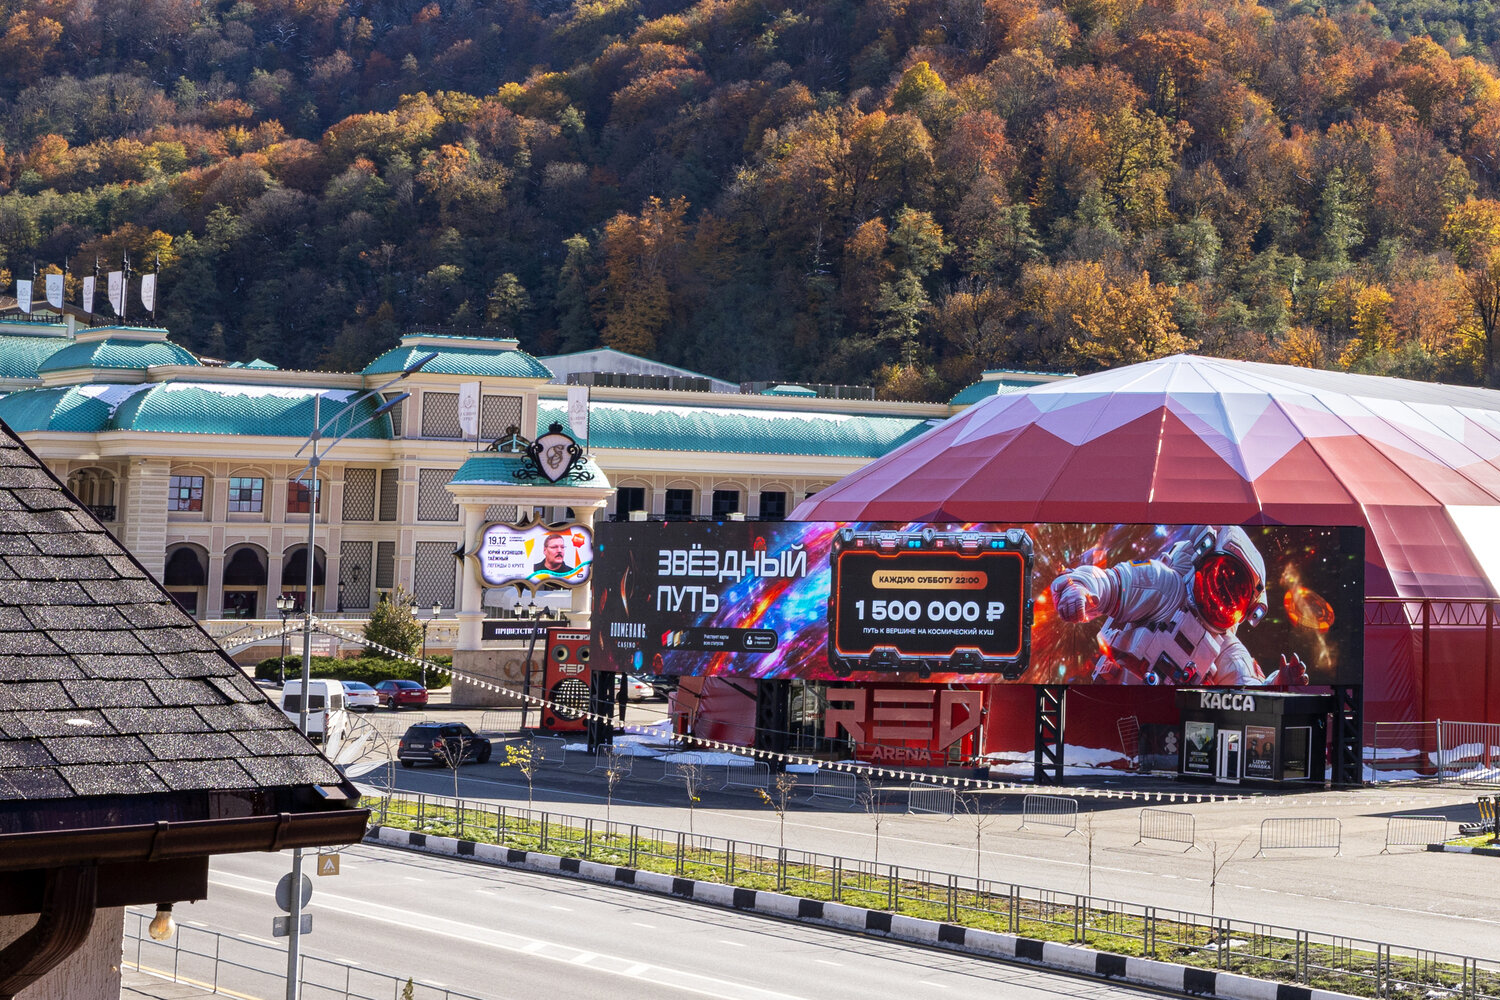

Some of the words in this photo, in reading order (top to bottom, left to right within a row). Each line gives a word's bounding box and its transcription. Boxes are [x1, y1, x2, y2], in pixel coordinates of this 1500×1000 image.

[488, 536, 507, 545] 19.12
[657, 543, 807, 583] ЗВЁЗДНЫЙ
[879, 576, 915, 584] КАЖДУЮ
[917, 576, 954, 584] СУББОТУ
[656, 585, 719, 613] ПУТЬ
[855, 600, 865, 620] 1
[871, 600, 922, 621] 500
[927, 601, 980, 622] 000
[927, 627, 978, 635] КОСМИЧЕСКИЙ
[617, 641, 637, 649] CASINO
[558, 663, 585, 674] RED
[1200, 692, 1255, 712] КАССА
[824, 688, 984, 752] RED
[871, 747, 932, 761] ARENA
